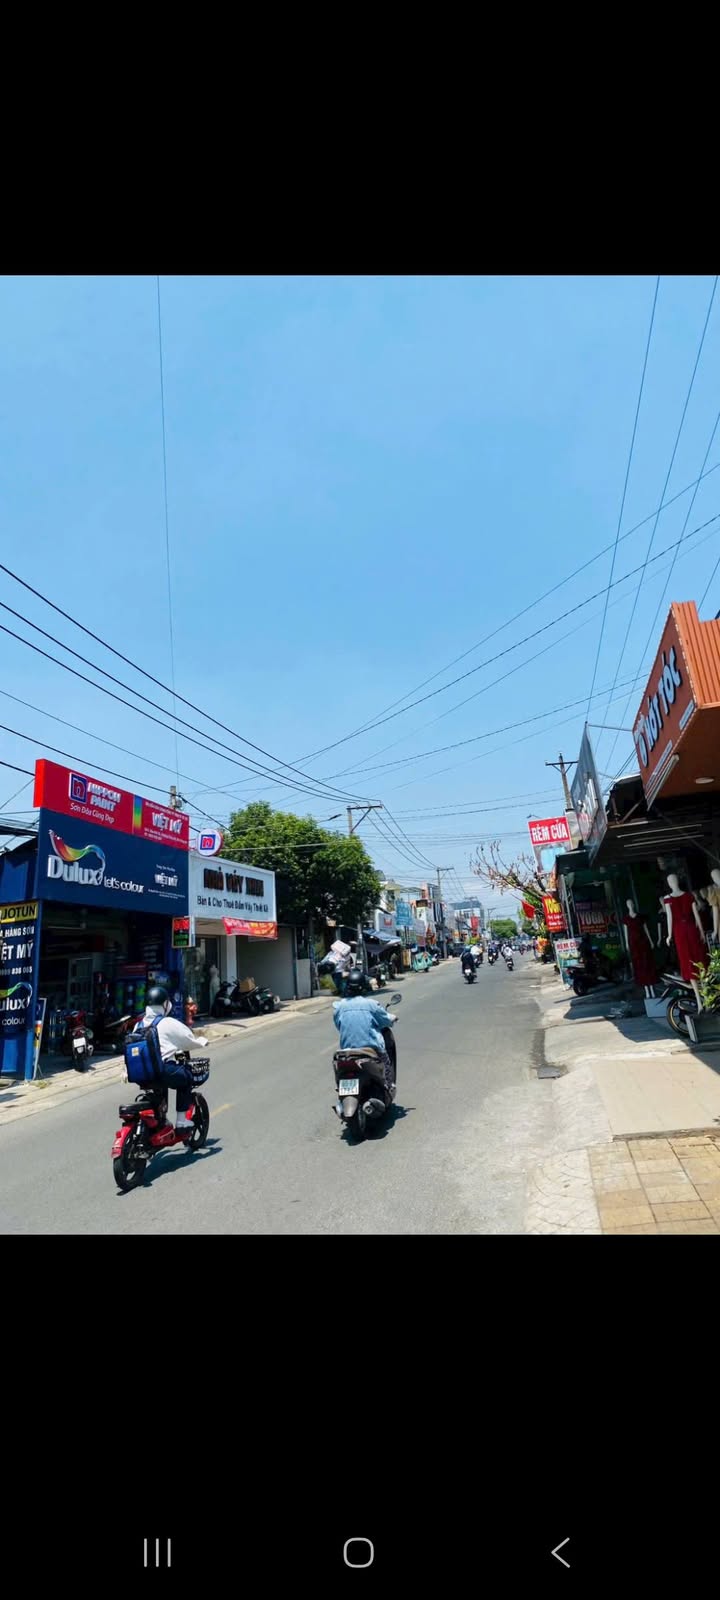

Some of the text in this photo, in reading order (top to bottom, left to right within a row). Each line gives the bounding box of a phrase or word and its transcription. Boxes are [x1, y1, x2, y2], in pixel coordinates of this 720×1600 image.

[47, 854, 104, 886] Dulux
[120, 880, 145, 894] colour
[213, 897, 222, 908] Cho
[2, 904, 37, 920] JOTUN
[579, 911, 605, 927] YOGA
[17, 939, 34, 960] MỸ
